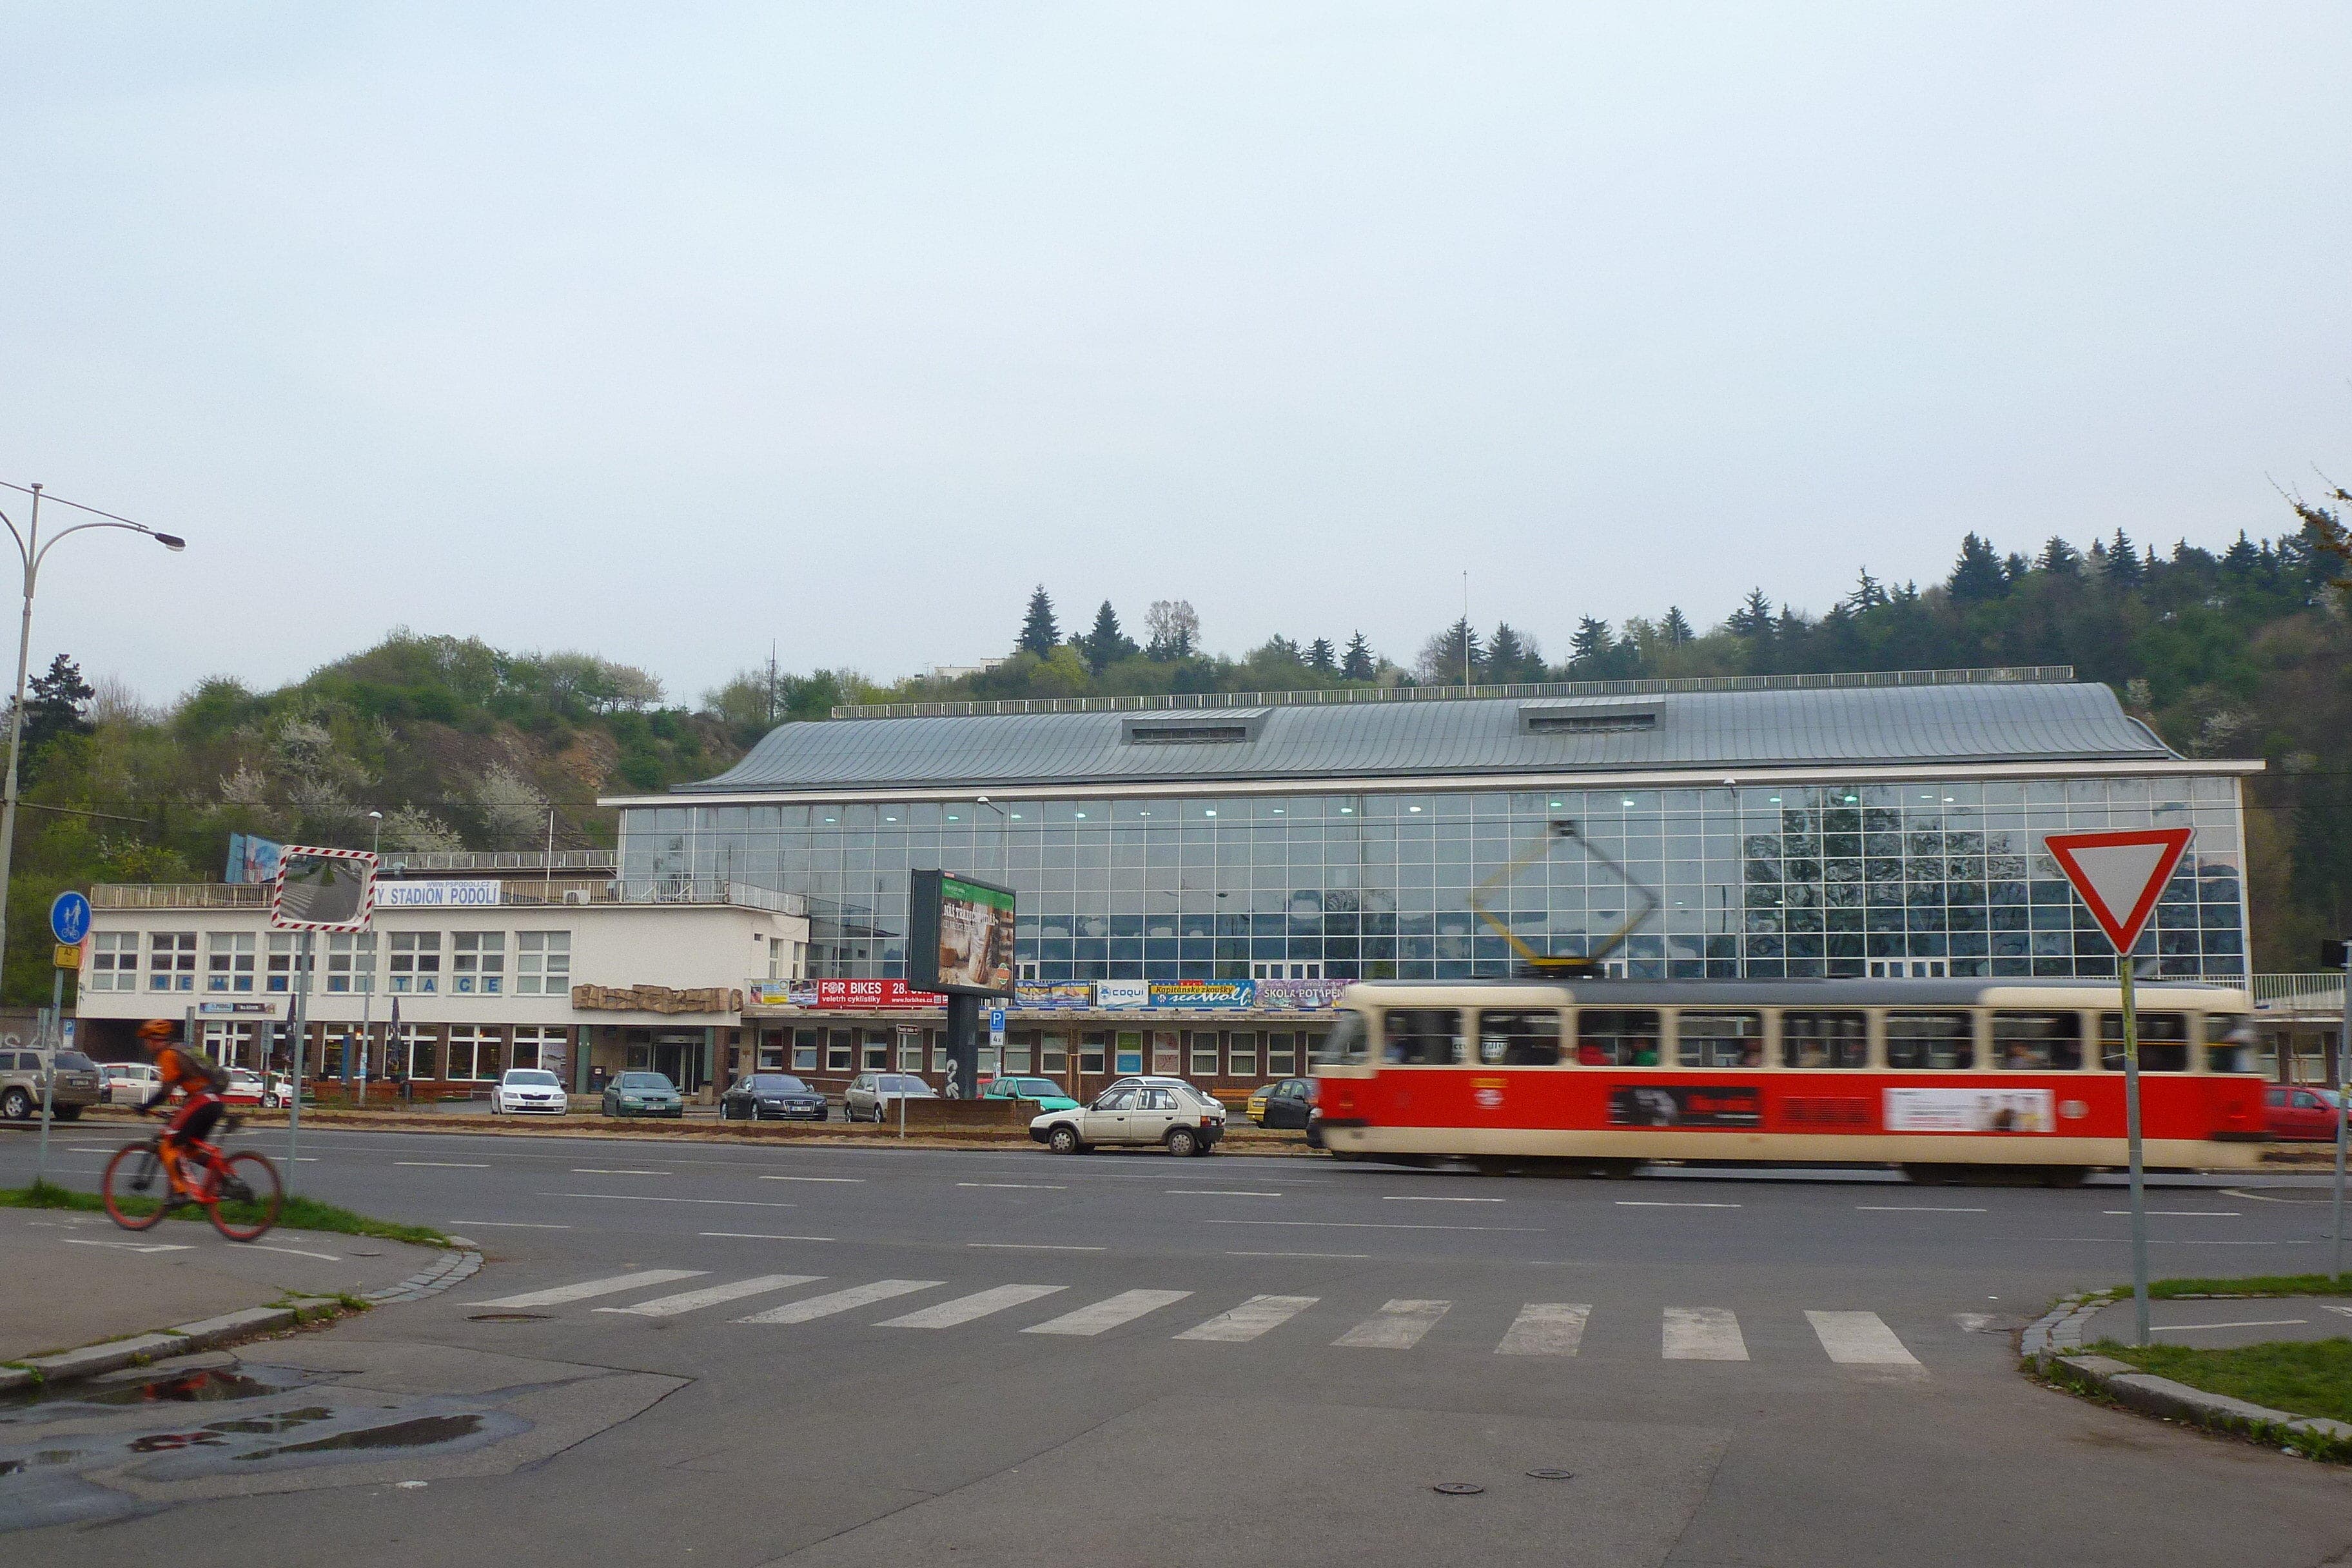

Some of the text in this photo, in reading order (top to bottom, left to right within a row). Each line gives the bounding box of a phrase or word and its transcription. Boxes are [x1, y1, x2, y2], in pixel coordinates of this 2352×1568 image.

[391, 888, 443, 905] STADION
[451, 882, 498, 905] PODOLÍ
[822, 982, 907, 994] FOR BIKES 28.
[1156, 986, 1233, 994] Kapitánské zkoušky
[1264, 986, 1296, 998] ŠKOLA
[847, 995, 881, 1004] cyklistiky
[994, 1012, 1002, 1025] P
[66, 1021, 72, 1031] P
